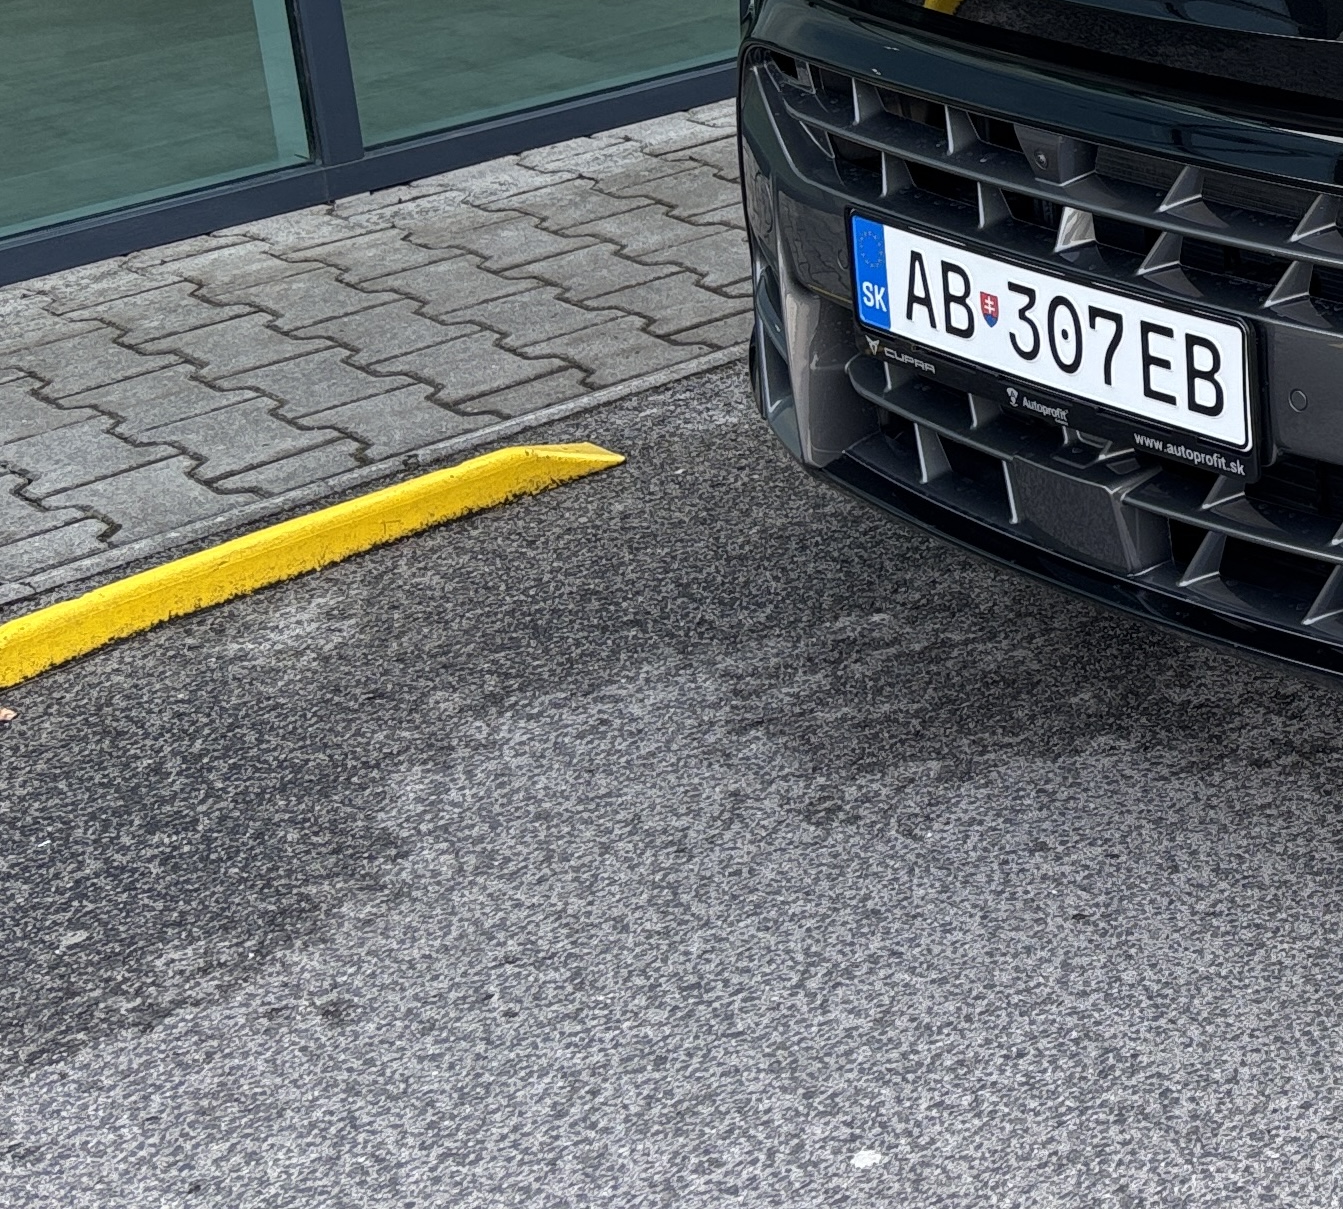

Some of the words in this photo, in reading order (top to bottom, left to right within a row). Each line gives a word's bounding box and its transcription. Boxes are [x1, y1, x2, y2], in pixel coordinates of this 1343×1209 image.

[861, 281, 888, 311] SK
[906, 250, 976, 341] AB
[883, 346, 937, 376] CUPRA
[1022, 396, 1069, 422] Autoprofit
[1133, 431, 1246, 476] www.autoprofit.sk
